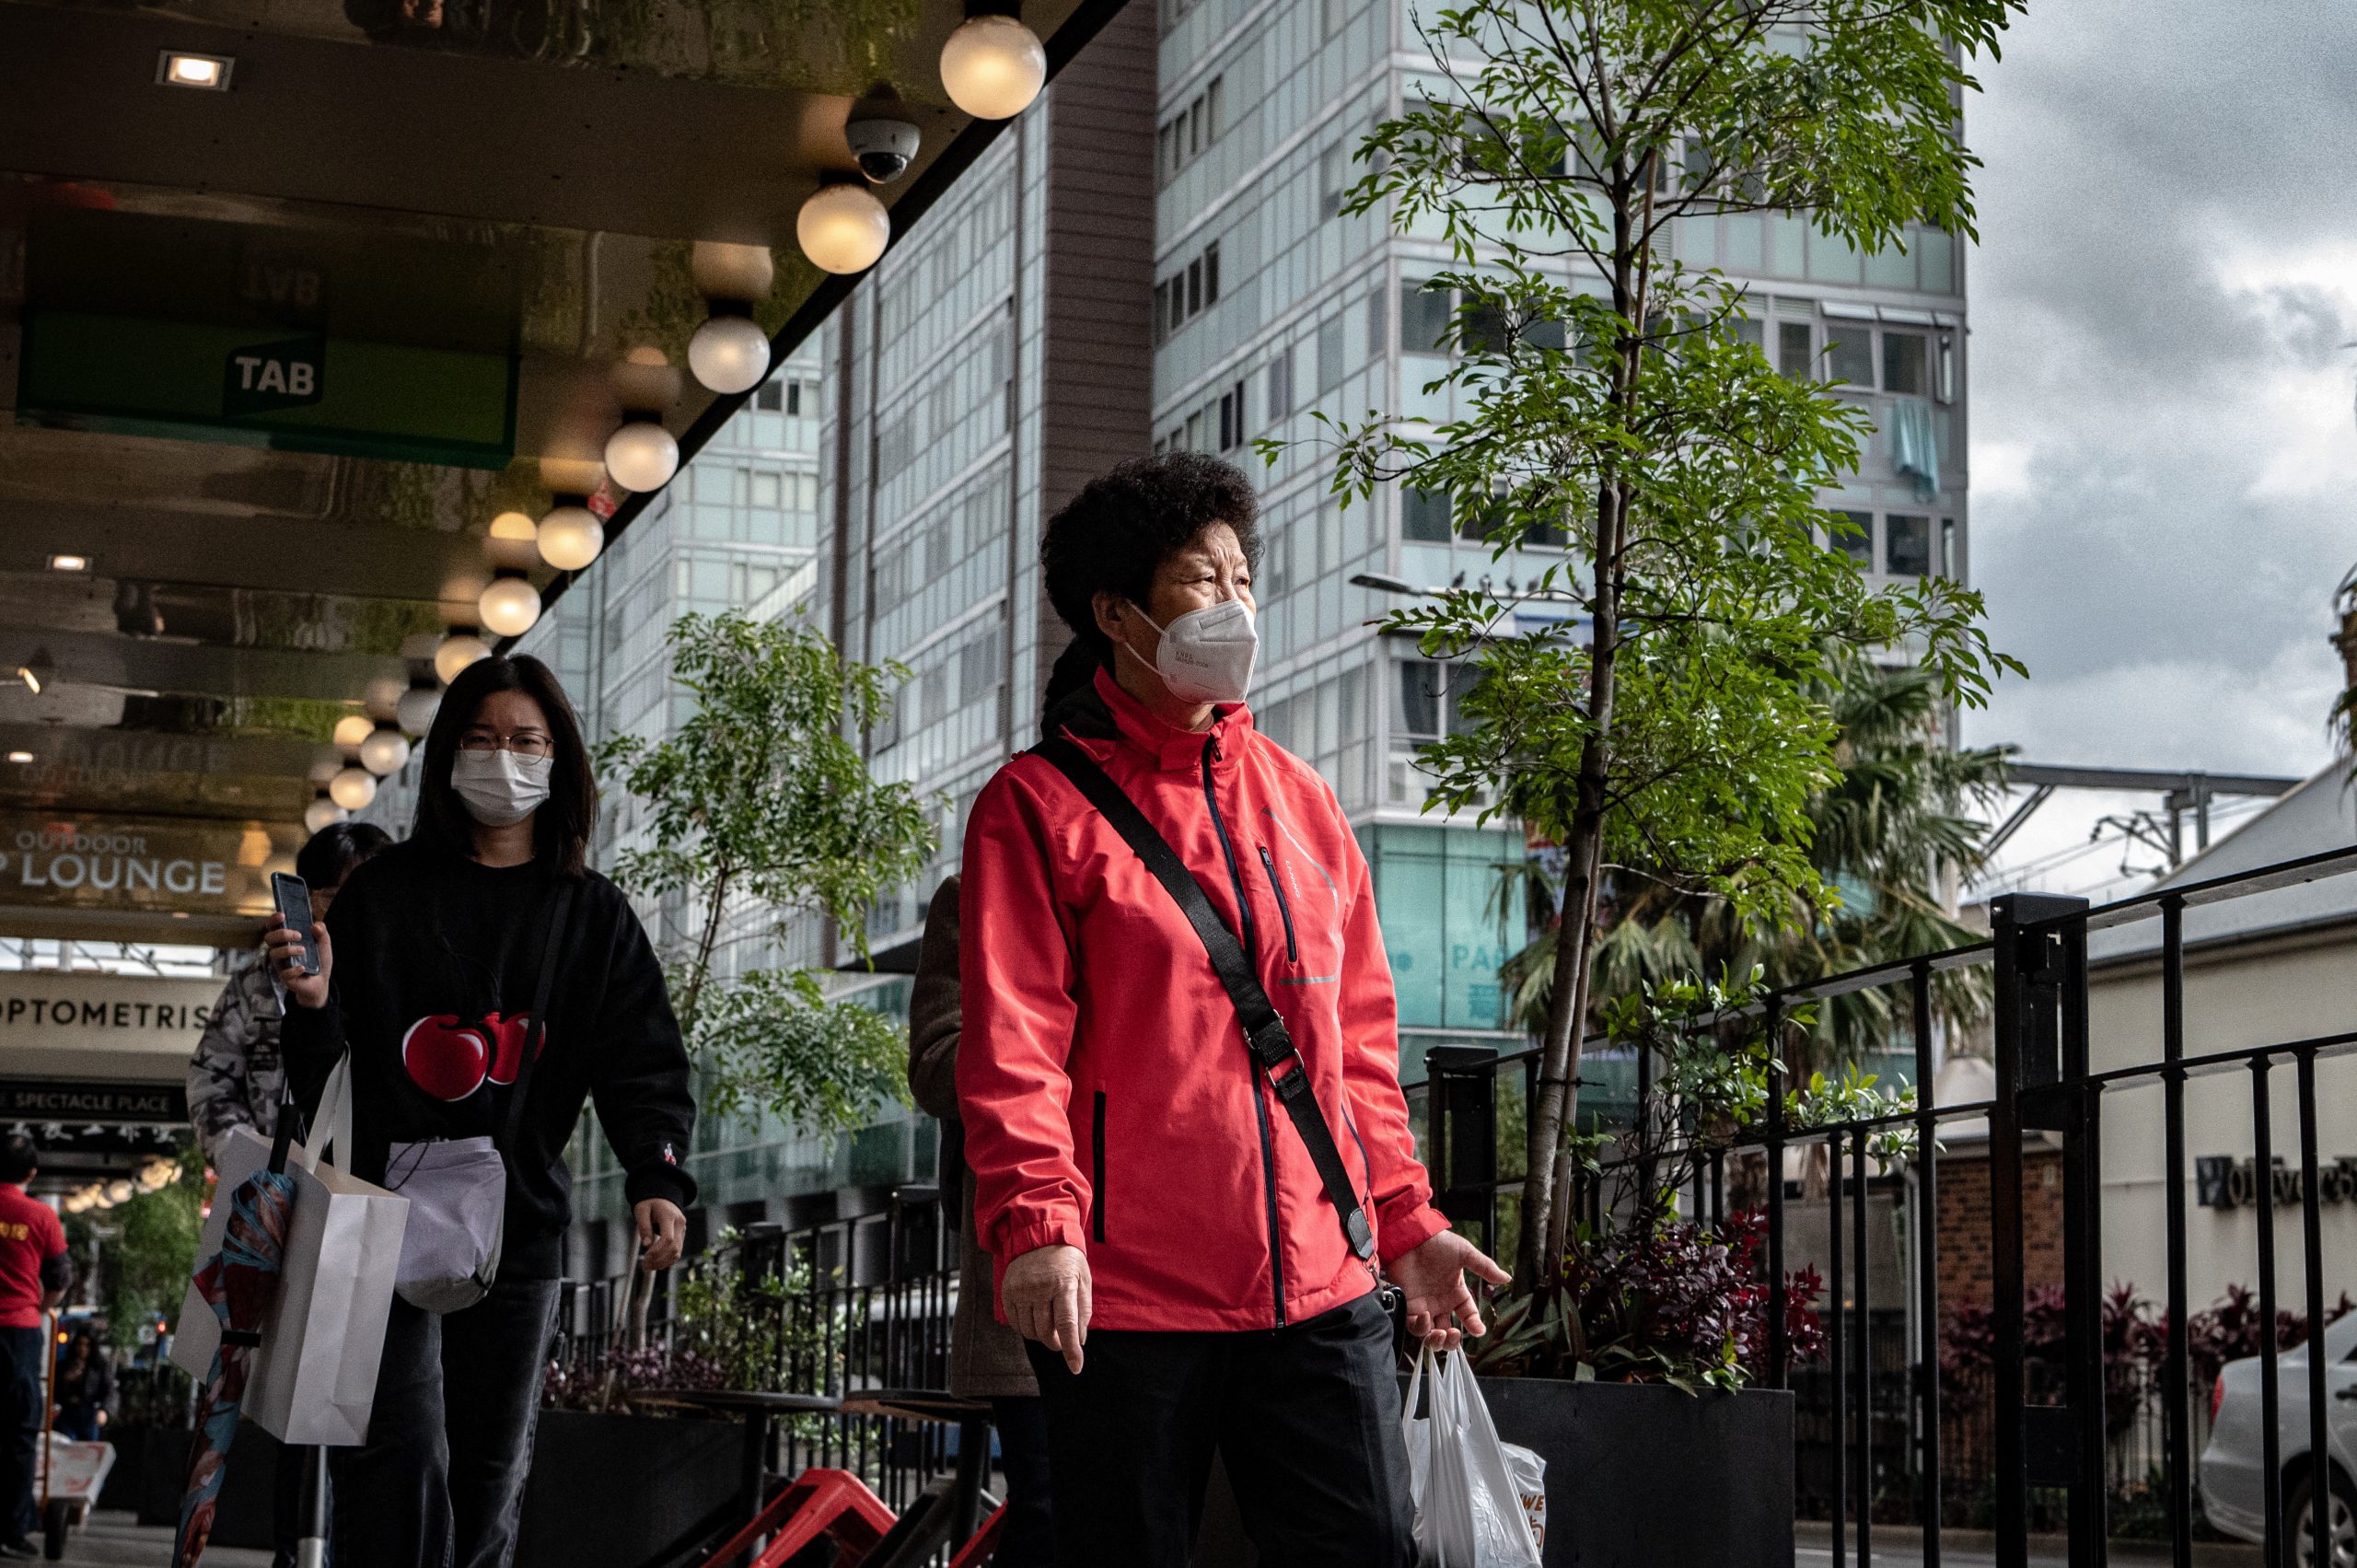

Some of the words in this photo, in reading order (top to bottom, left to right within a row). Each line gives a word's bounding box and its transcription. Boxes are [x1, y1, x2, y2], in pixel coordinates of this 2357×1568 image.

[235, 356, 315, 396] TAB
[15, 830, 147, 854] OUTDOOR
[21, 853, 226, 895] LOUNGE
[0, 997, 211, 1029] PTOMETRIS
[15, 1093, 112, 1111] SPECTACLE
[117, 1096, 169, 1113] PLACE
[1520, 1493, 1545, 1512] WE
